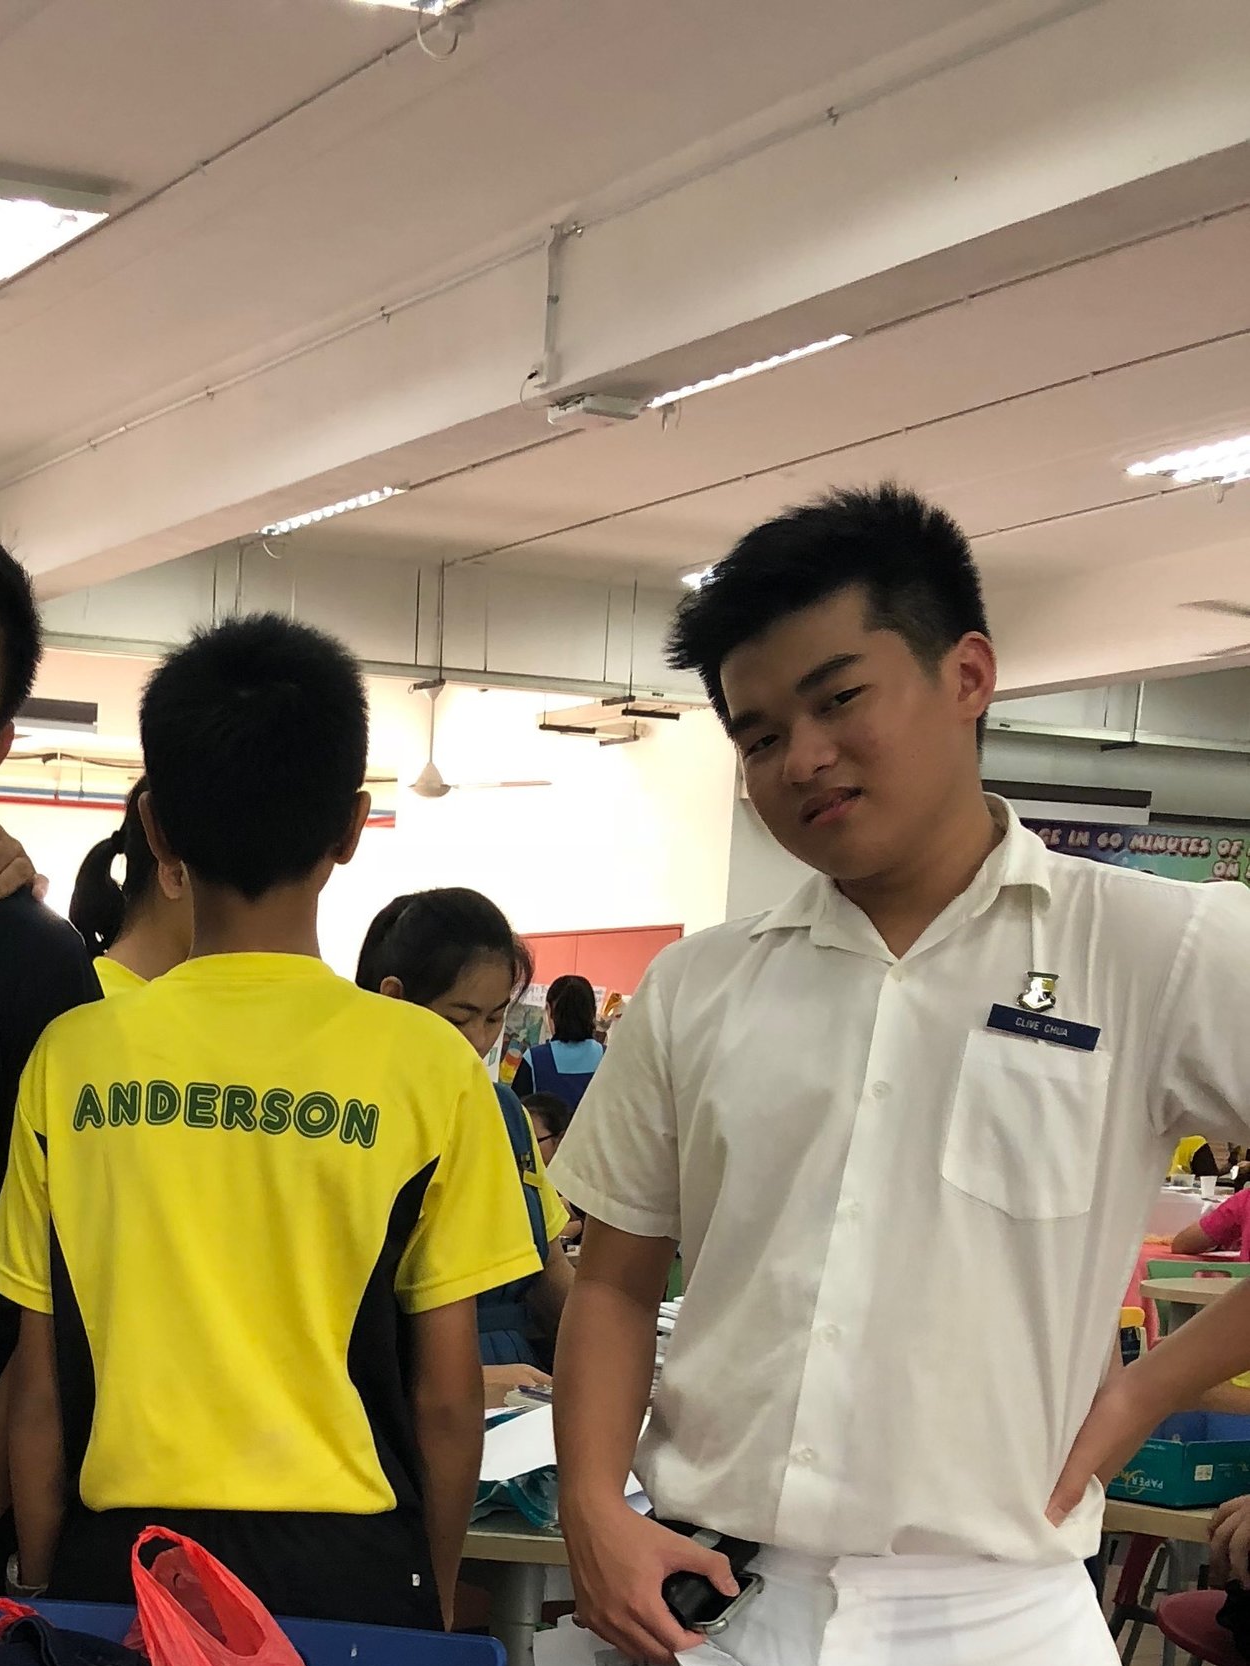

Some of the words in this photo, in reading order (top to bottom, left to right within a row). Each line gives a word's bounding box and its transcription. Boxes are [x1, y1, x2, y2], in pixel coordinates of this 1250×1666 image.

[1129, 833, 1212, 857] MINUTES
[1217, 837, 1244, 857] OF
[1015, 1017, 1040, 1031] CLIVE
[1044, 1023, 1068, 1037] CHUA
[73, 1079, 379, 1149] ANDERSON
